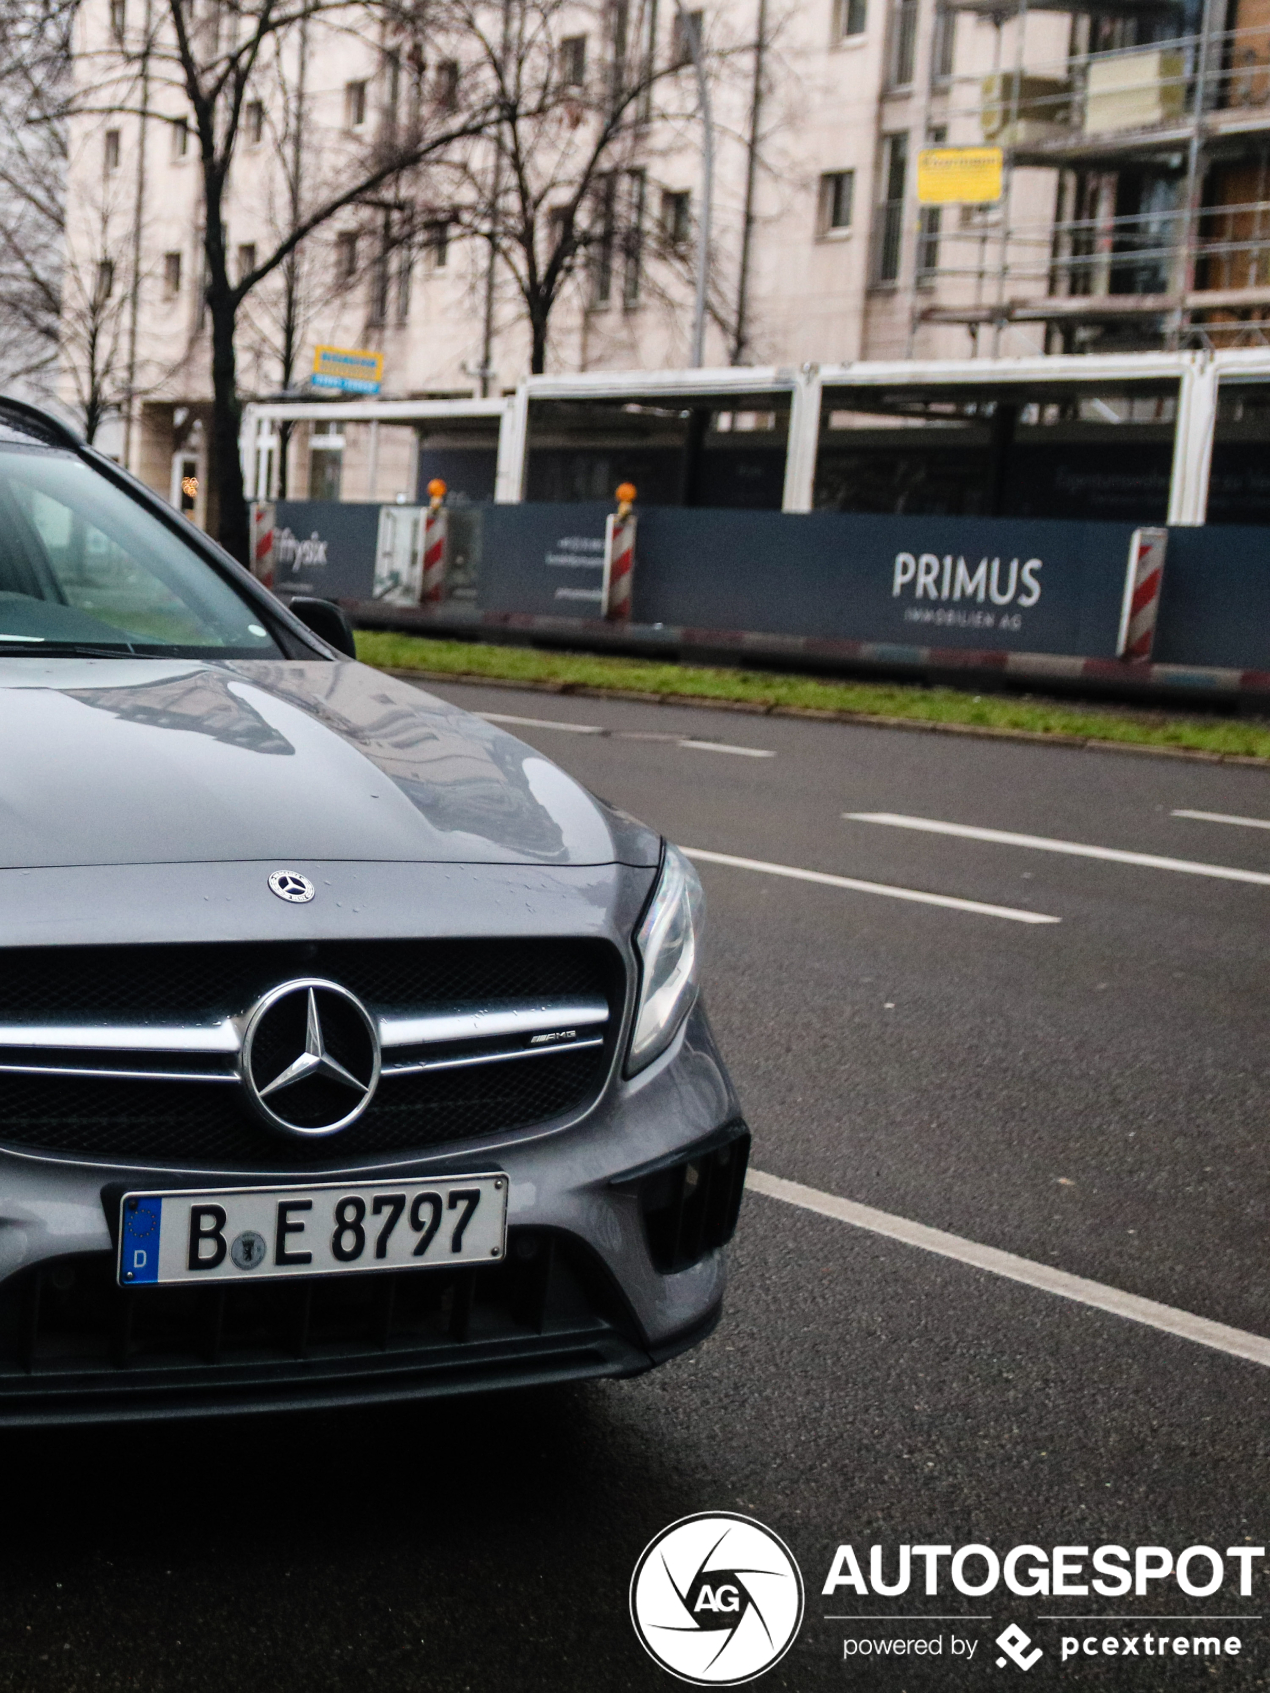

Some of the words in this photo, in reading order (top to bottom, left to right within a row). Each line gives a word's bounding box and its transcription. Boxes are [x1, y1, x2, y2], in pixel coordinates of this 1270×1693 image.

[892, 552, 1043, 608] PRIMUS
[904, 607, 995, 629] IMMOBILIEN
[999, 613, 1022, 632] AG
[188, 1203, 228, 1271] B
[274, 1199, 313, 1266] E
[331, 1188, 481, 1263] 8797
[134, 1250, 147, 1268] D
